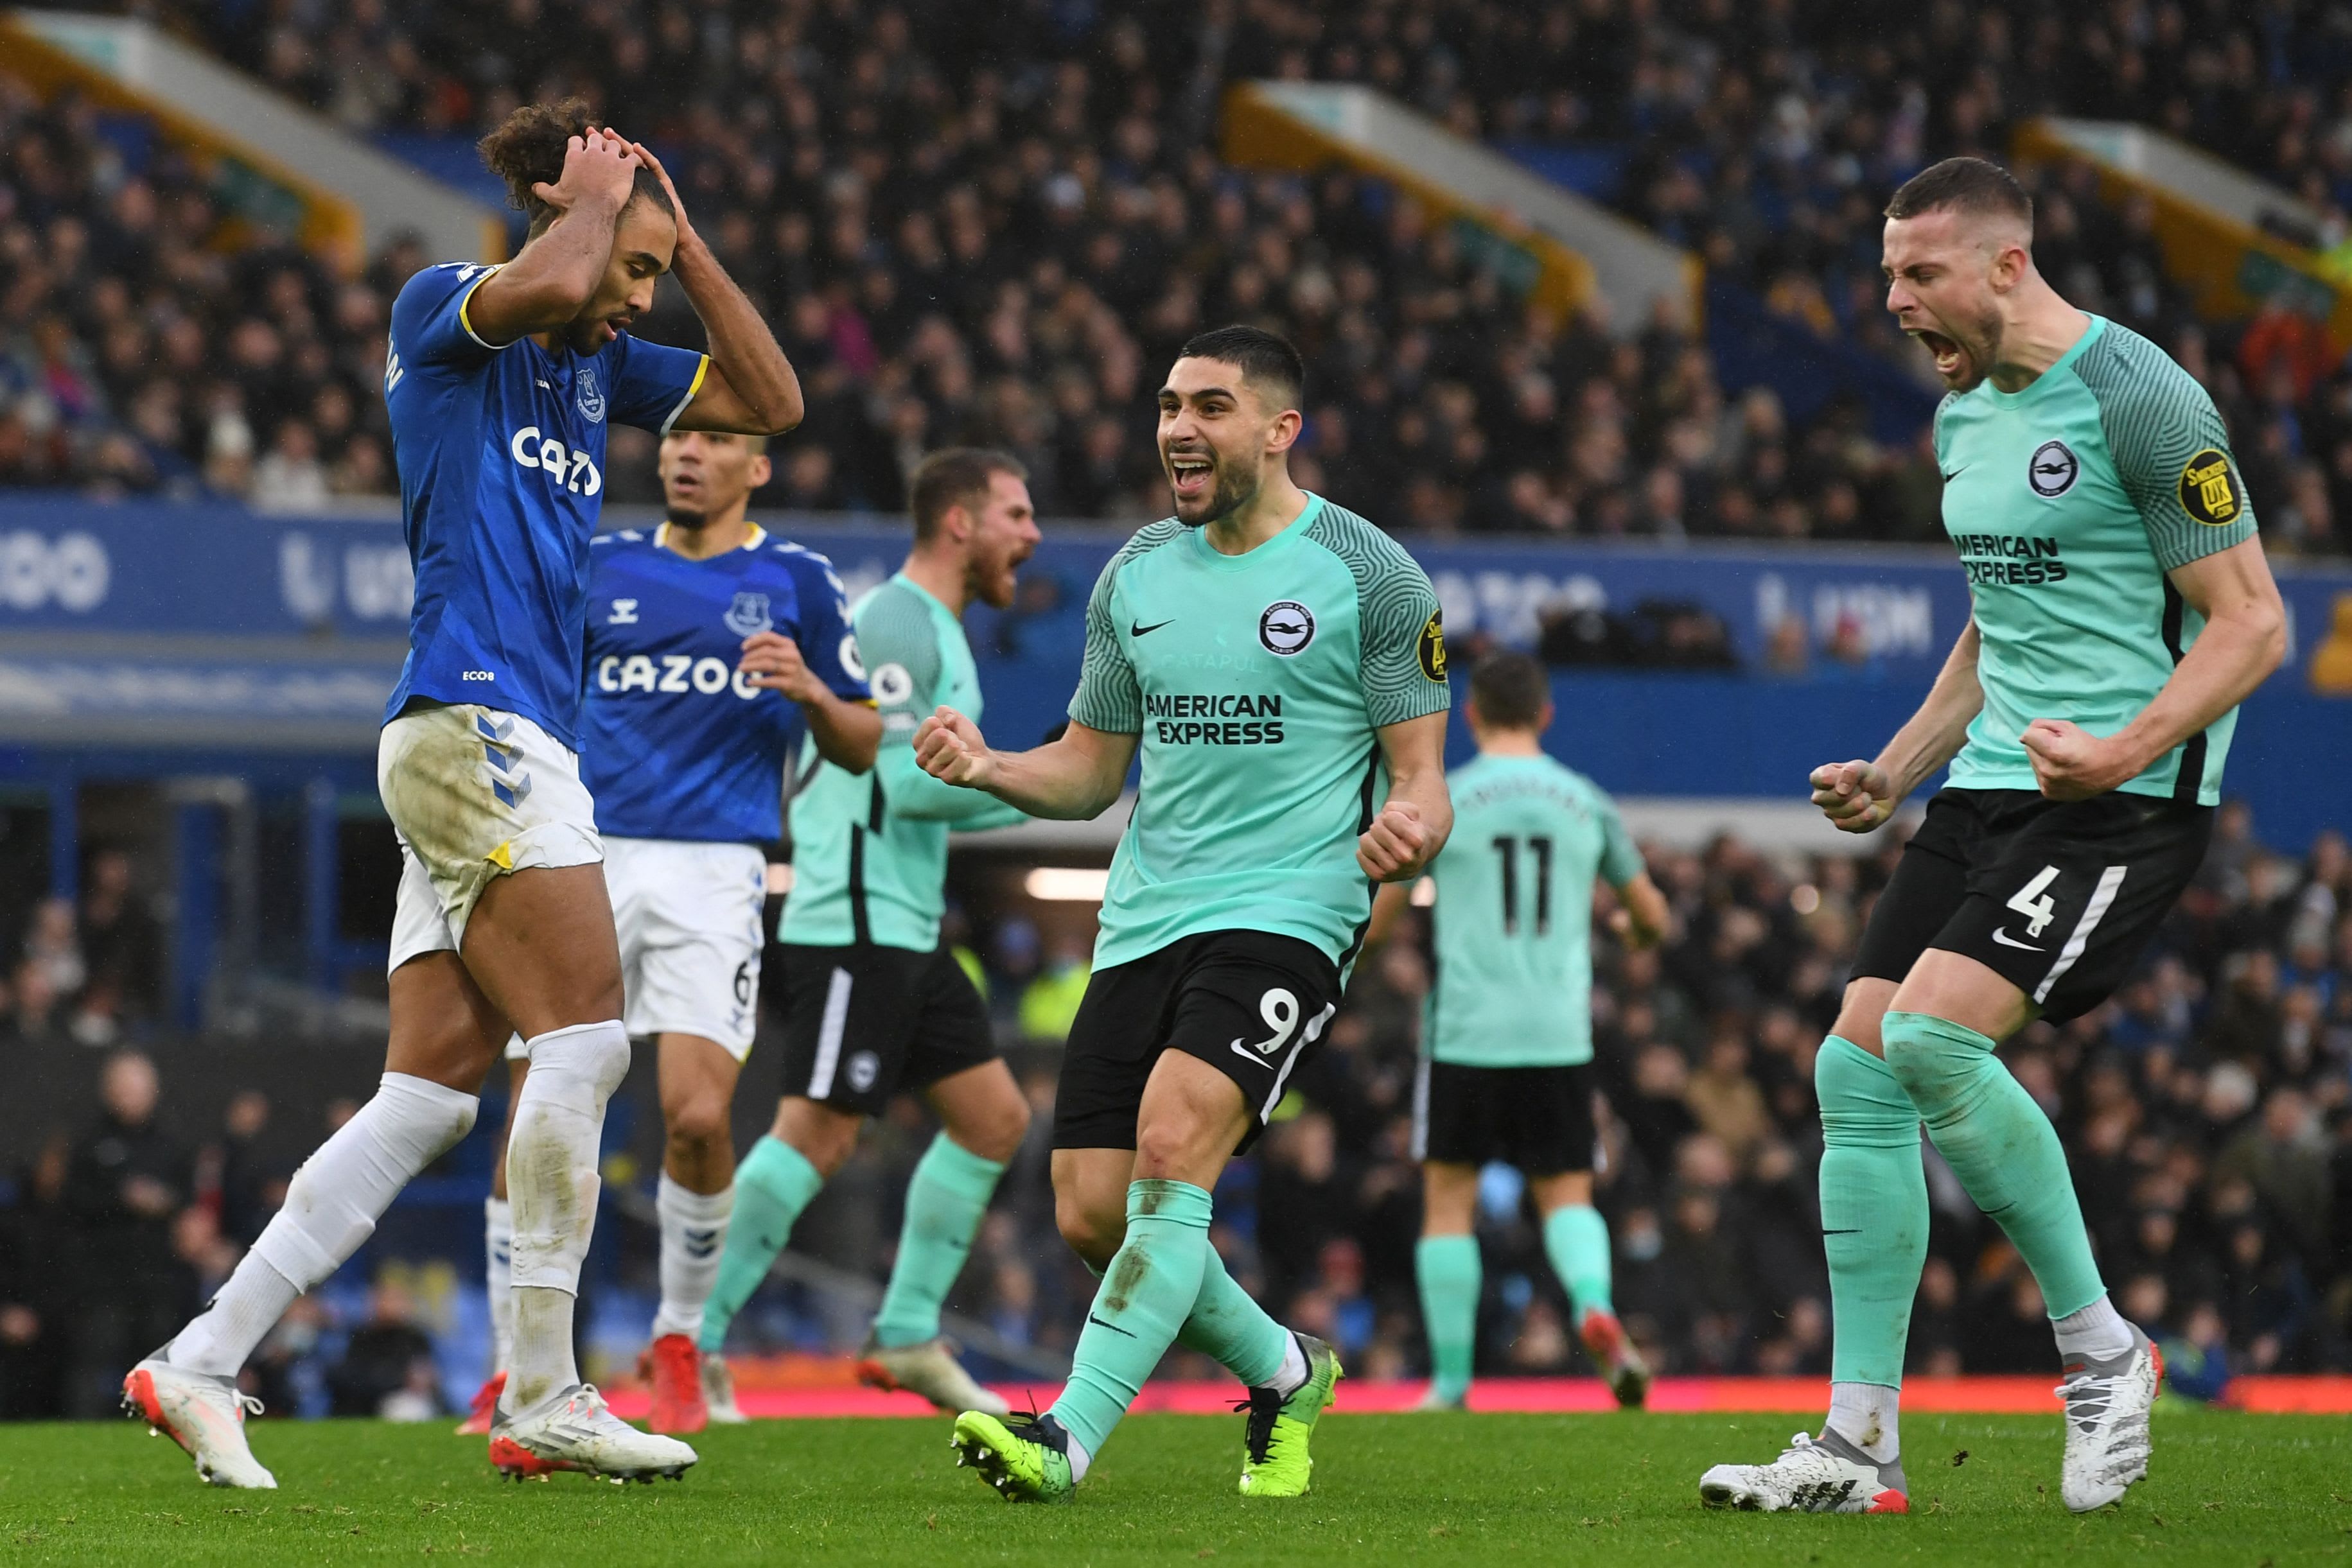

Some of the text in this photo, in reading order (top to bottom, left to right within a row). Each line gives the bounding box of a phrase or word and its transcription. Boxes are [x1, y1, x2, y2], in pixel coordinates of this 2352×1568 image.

[2205, 479, 2229, 505] UK
[1954, 535, 2058, 558] MERICAN
[462, 670, 495, 681] ECO8
[1146, 695, 1281, 717] AMERICAN
[1157, 722, 1284, 745] EXPRESS
[1490, 837, 1553, 936] 11
[2006, 864, 2061, 938] 4
[734, 961, 750, 1007] 6
[1254, 988, 1300, 1055] 9
